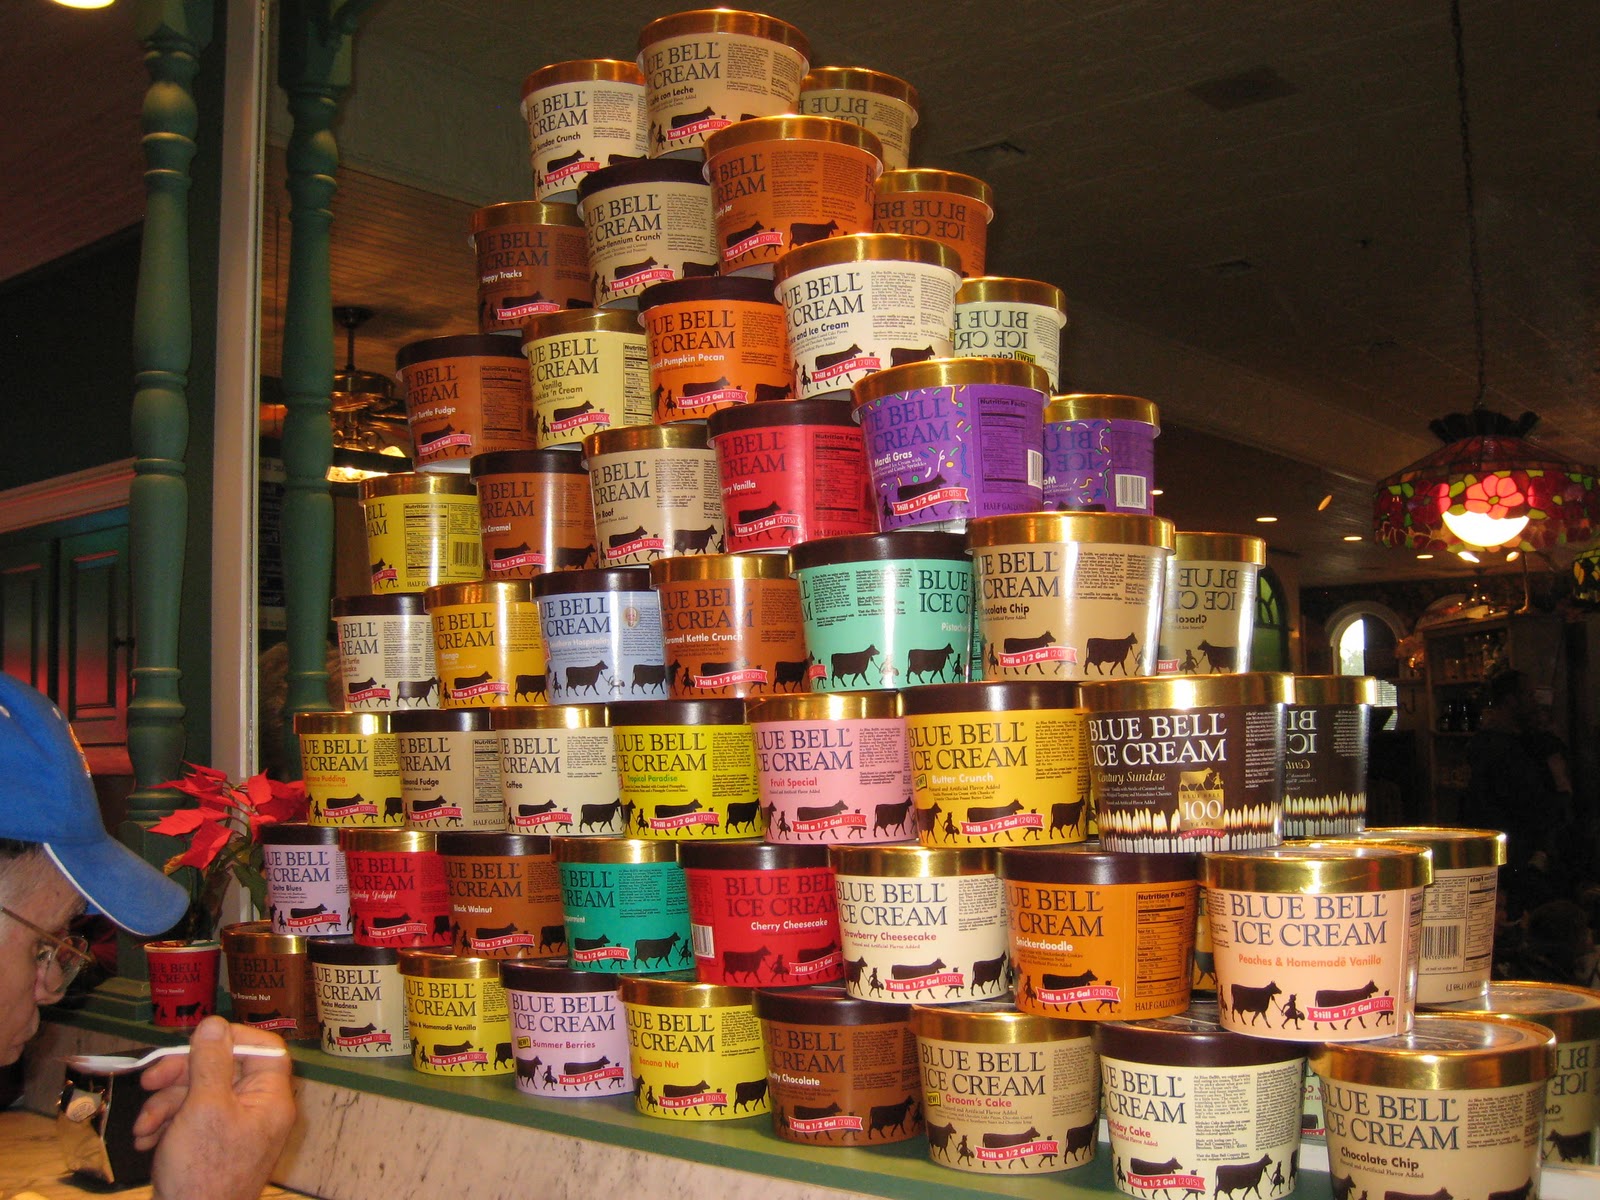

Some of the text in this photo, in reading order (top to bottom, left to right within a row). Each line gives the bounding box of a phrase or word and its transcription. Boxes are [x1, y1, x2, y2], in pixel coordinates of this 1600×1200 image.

[669, 42, 720, 65] BELL
[652, 62, 720, 90] CREAM
[673, 86, 694, 96] Leche
[542, 91, 588, 110] BELL
[556, 132, 581, 144] Crunch
[610, 194, 661, 217] BELL
[595, 213, 662, 242] CREAM
[635, 232, 661, 241] Crunch
[500, 270, 522, 279] Tracks
[807, 273, 863, 301] BELL
[679, 310, 736, 330] BELL
[793, 294, 864, 328] CREAM
[797, 320, 849, 342] and Ice Cream
[549, 339, 599, 359] BELL
[661, 331, 736, 354] CREAM
[664, 353, 725, 368] Pumpkin Pecan
[537, 358, 599, 382] CREAM
[541, 381, 563, 391] Vanilla
[558, 386, 583, 395] Cream
[434, 406, 457, 416] Fudge
[893, 398, 951, 428] BELL
[874, 421, 951, 454] CREAM
[874, 451, 913, 467] Mardi Gras
[603, 461, 649, 484] BELL
[733, 480, 757, 491] Vanilla
[601, 508, 614, 519] Roof
[999, 551, 1061, 574] BELL
[919, 570, 968, 591] BLUE
[560, 596, 610, 616] BELL
[919, 593, 952, 613] ICE
[1010, 603, 1030, 616] Chip
[447, 612, 495, 630] BELL
[547, 614, 612, 638] CREAM
[438, 631, 495, 650] CREAM
[686, 632, 743, 643] Kettle Crunch
[910, 722, 1028, 747] BLUE BELL
[1090, 713, 1228, 742] BLUE BELL
[324, 740, 369, 755] BELL
[410, 737, 451, 753] BELL
[513, 738, 560, 755] BELL
[650, 733, 707, 751] BELL
[791, 728, 853, 749] BELL
[772, 750, 853, 772] CREAM
[912, 747, 1028, 771] ICE CREAM
[1093, 739, 1227, 766] ICE CREAM
[310, 756, 368, 771] CREAM
[503, 756, 560, 774] CREAM
[632, 753, 707, 772] CREAM
[322, 775, 346, 784] Pudding
[420, 778, 439, 787] Fudge
[506, 780, 523, 789] Coffee
[648, 773, 678, 782] Paradise
[770, 777, 817, 790] Fruit Special
[932, 773, 994, 784] Butter Crunch
[1127, 771, 1166, 783] Sundae
[1183, 800, 1222, 820] 100
[966, 818, 1018, 833] Still 1/2 Gal
[286, 852, 330, 866] BELL
[273, 868, 330, 882] CREAM
[472, 861, 522, 879] BELL
[372, 891, 397, 903] Delight
[456, 881, 522, 898] CREAM
[836, 881, 947, 903] BLUE BELL
[468, 904, 492, 913] Walnut
[1036, 890, 1103, 911] BELL
[1229, 894, 1388, 920] BLUE BELL
[839, 903, 947, 926] ICE CREAM
[751, 918, 828, 932] Cherry Cheesecake
[1019, 912, 1104, 936] CREAM
[1232, 920, 1387, 946] ICE CREAM
[844, 929, 936, 942] Strawberry Cheesecake
[1016, 937, 1073, 951] Snickerdoodle
[1239, 954, 1272, 966] Peaches
[1275, 957, 1283, 966] &
[1350, 953, 1381, 966] Vanilla
[336, 969, 381, 984] BELL
[323, 986, 382, 1001] CREAM
[428, 983, 477, 999] BELL
[415, 1000, 477, 1017] CREAM
[512, 993, 555, 1014] BLUE
[562, 994, 616, 1013] BELL
[1135, 1001, 1153, 1011] HALF
[1313, 1010, 1331, 1019] Still
[1342, 1006, 1356, 1017] 1/2
[1358, 1002, 1372, 1013] Gal
[514, 1012, 616, 1033] ICE CREAM
[657, 1013, 715, 1032] BELL
[533, 1040, 562, 1049] Summer
[566, 1040, 596, 1049] Berries
[641, 1031, 715, 1053] CREAM
[787, 1030, 845, 1051] BELL
[639, 1057, 680, 1069] Banana Nut
[772, 1050, 846, 1073] CREAM
[921, 1043, 971, 1071] BLUE
[976, 1051, 1046, 1073] BELL
[783, 1074, 820, 1086] Chocolate
[924, 1066, 1046, 1096] ICE CREAM
[1120, 1069, 1185, 1098] BELL
[946, 1094, 982, 1107] Groom's
[986, 1098, 1012, 1108] Cake
[1108, 1091, 1187, 1124] CREAM
[1376, 1094, 1460, 1122] BELL
[1130, 1125, 1151, 1138] Cake
[1351, 1117, 1460, 1150] CREAM
[1341, 1146, 1419, 1171] Chocolate Chip
